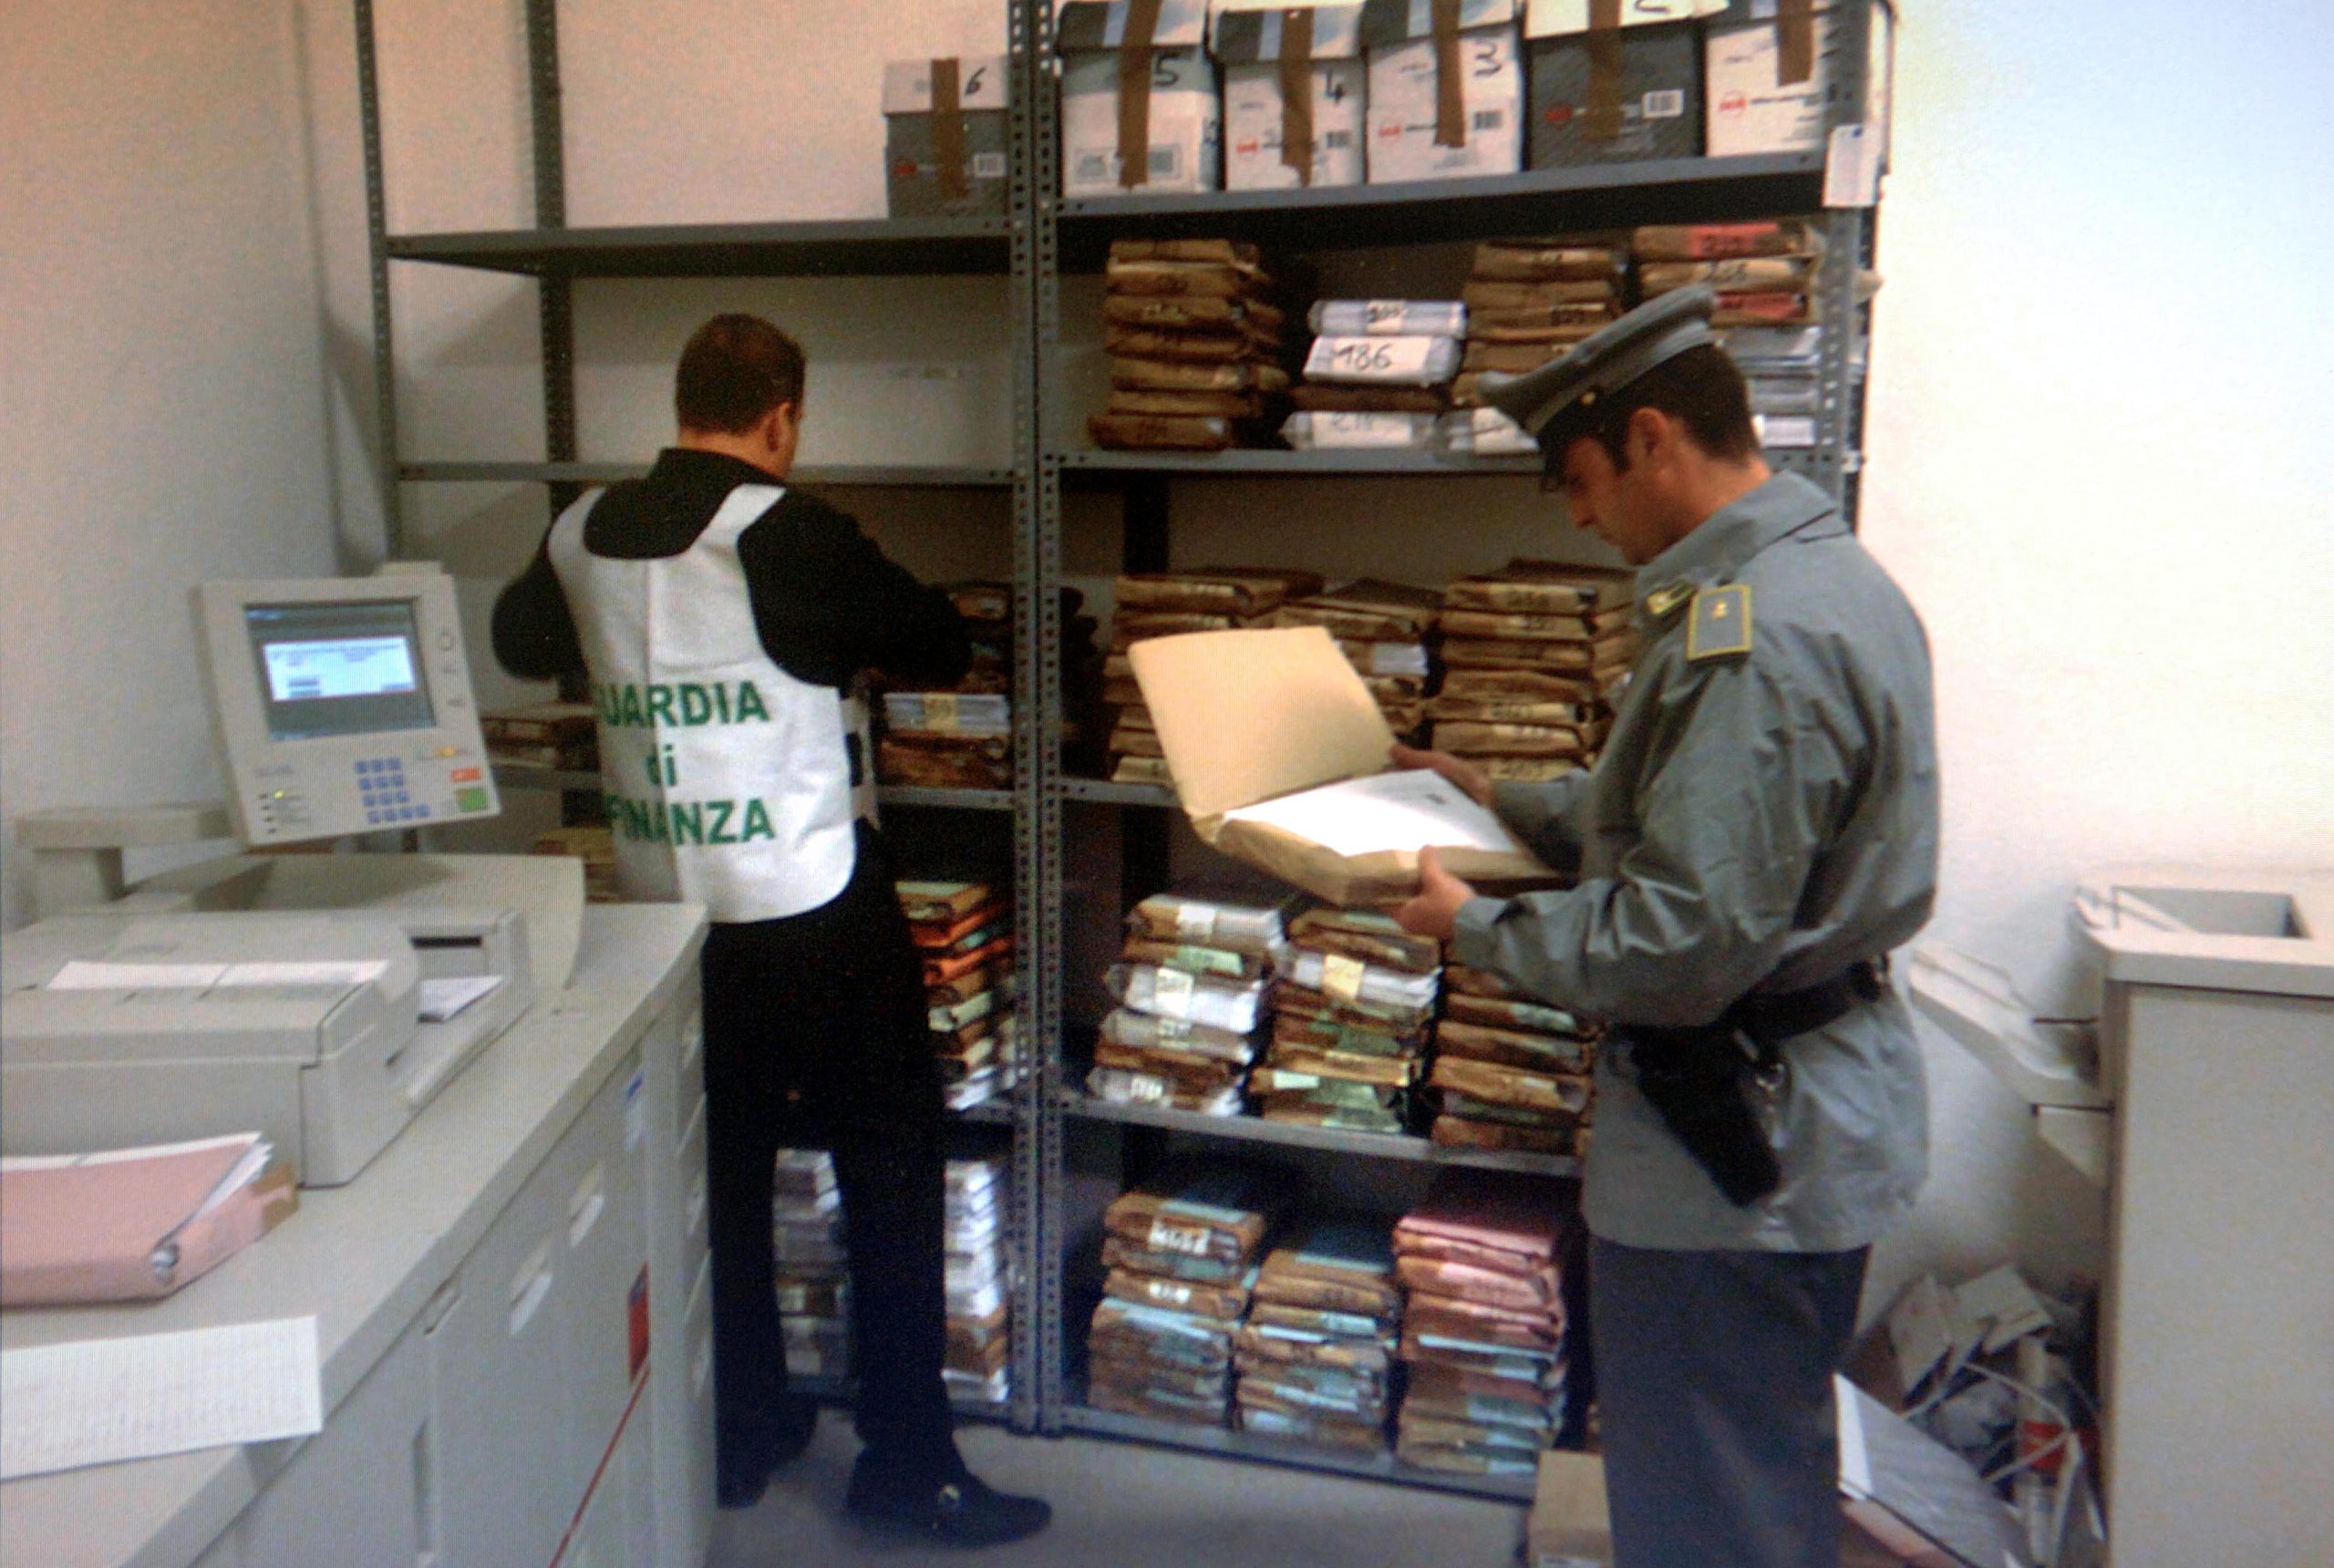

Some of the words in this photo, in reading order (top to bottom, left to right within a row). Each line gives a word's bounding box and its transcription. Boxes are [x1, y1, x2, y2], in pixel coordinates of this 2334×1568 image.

[1153, 53, 1183, 87] 5
[1473, 42, 1503, 77] 3
[965, 66, 986, 95] 6
[1324, 67, 1347, 104] 4
[1330, 343, 1394, 370] 186
[594, 680, 769, 727] UARDIA
